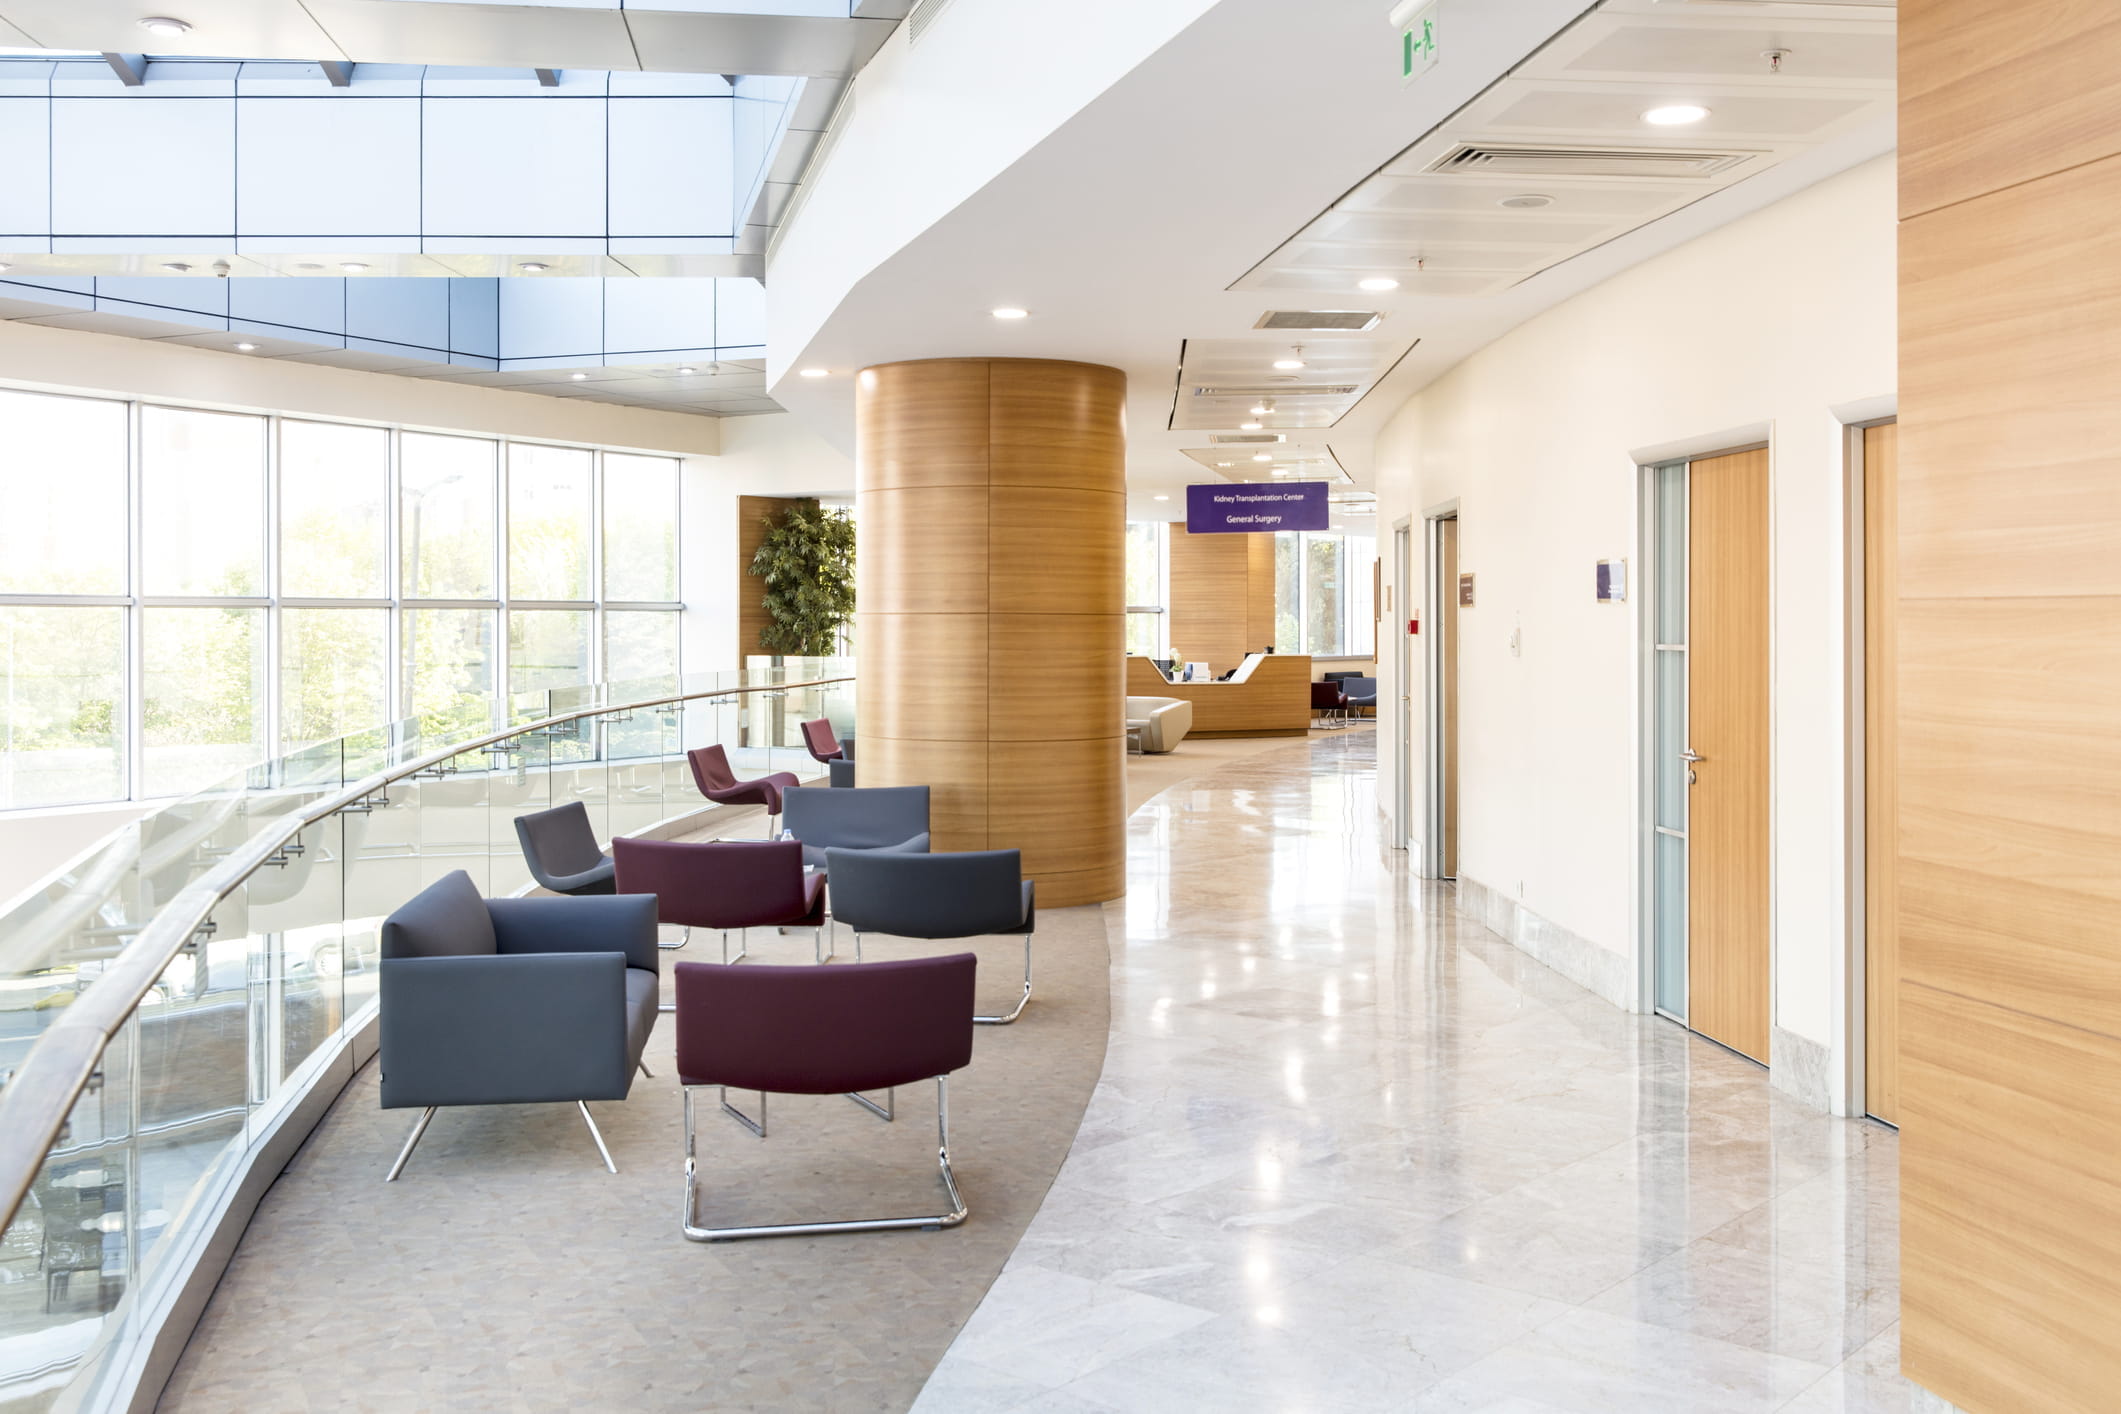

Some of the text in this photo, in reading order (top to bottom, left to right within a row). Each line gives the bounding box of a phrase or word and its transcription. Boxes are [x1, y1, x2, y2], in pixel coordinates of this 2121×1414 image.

[1214, 493, 1304, 504] Kidney Transplantation Center
[1226, 514, 1282, 524] General Surgery
